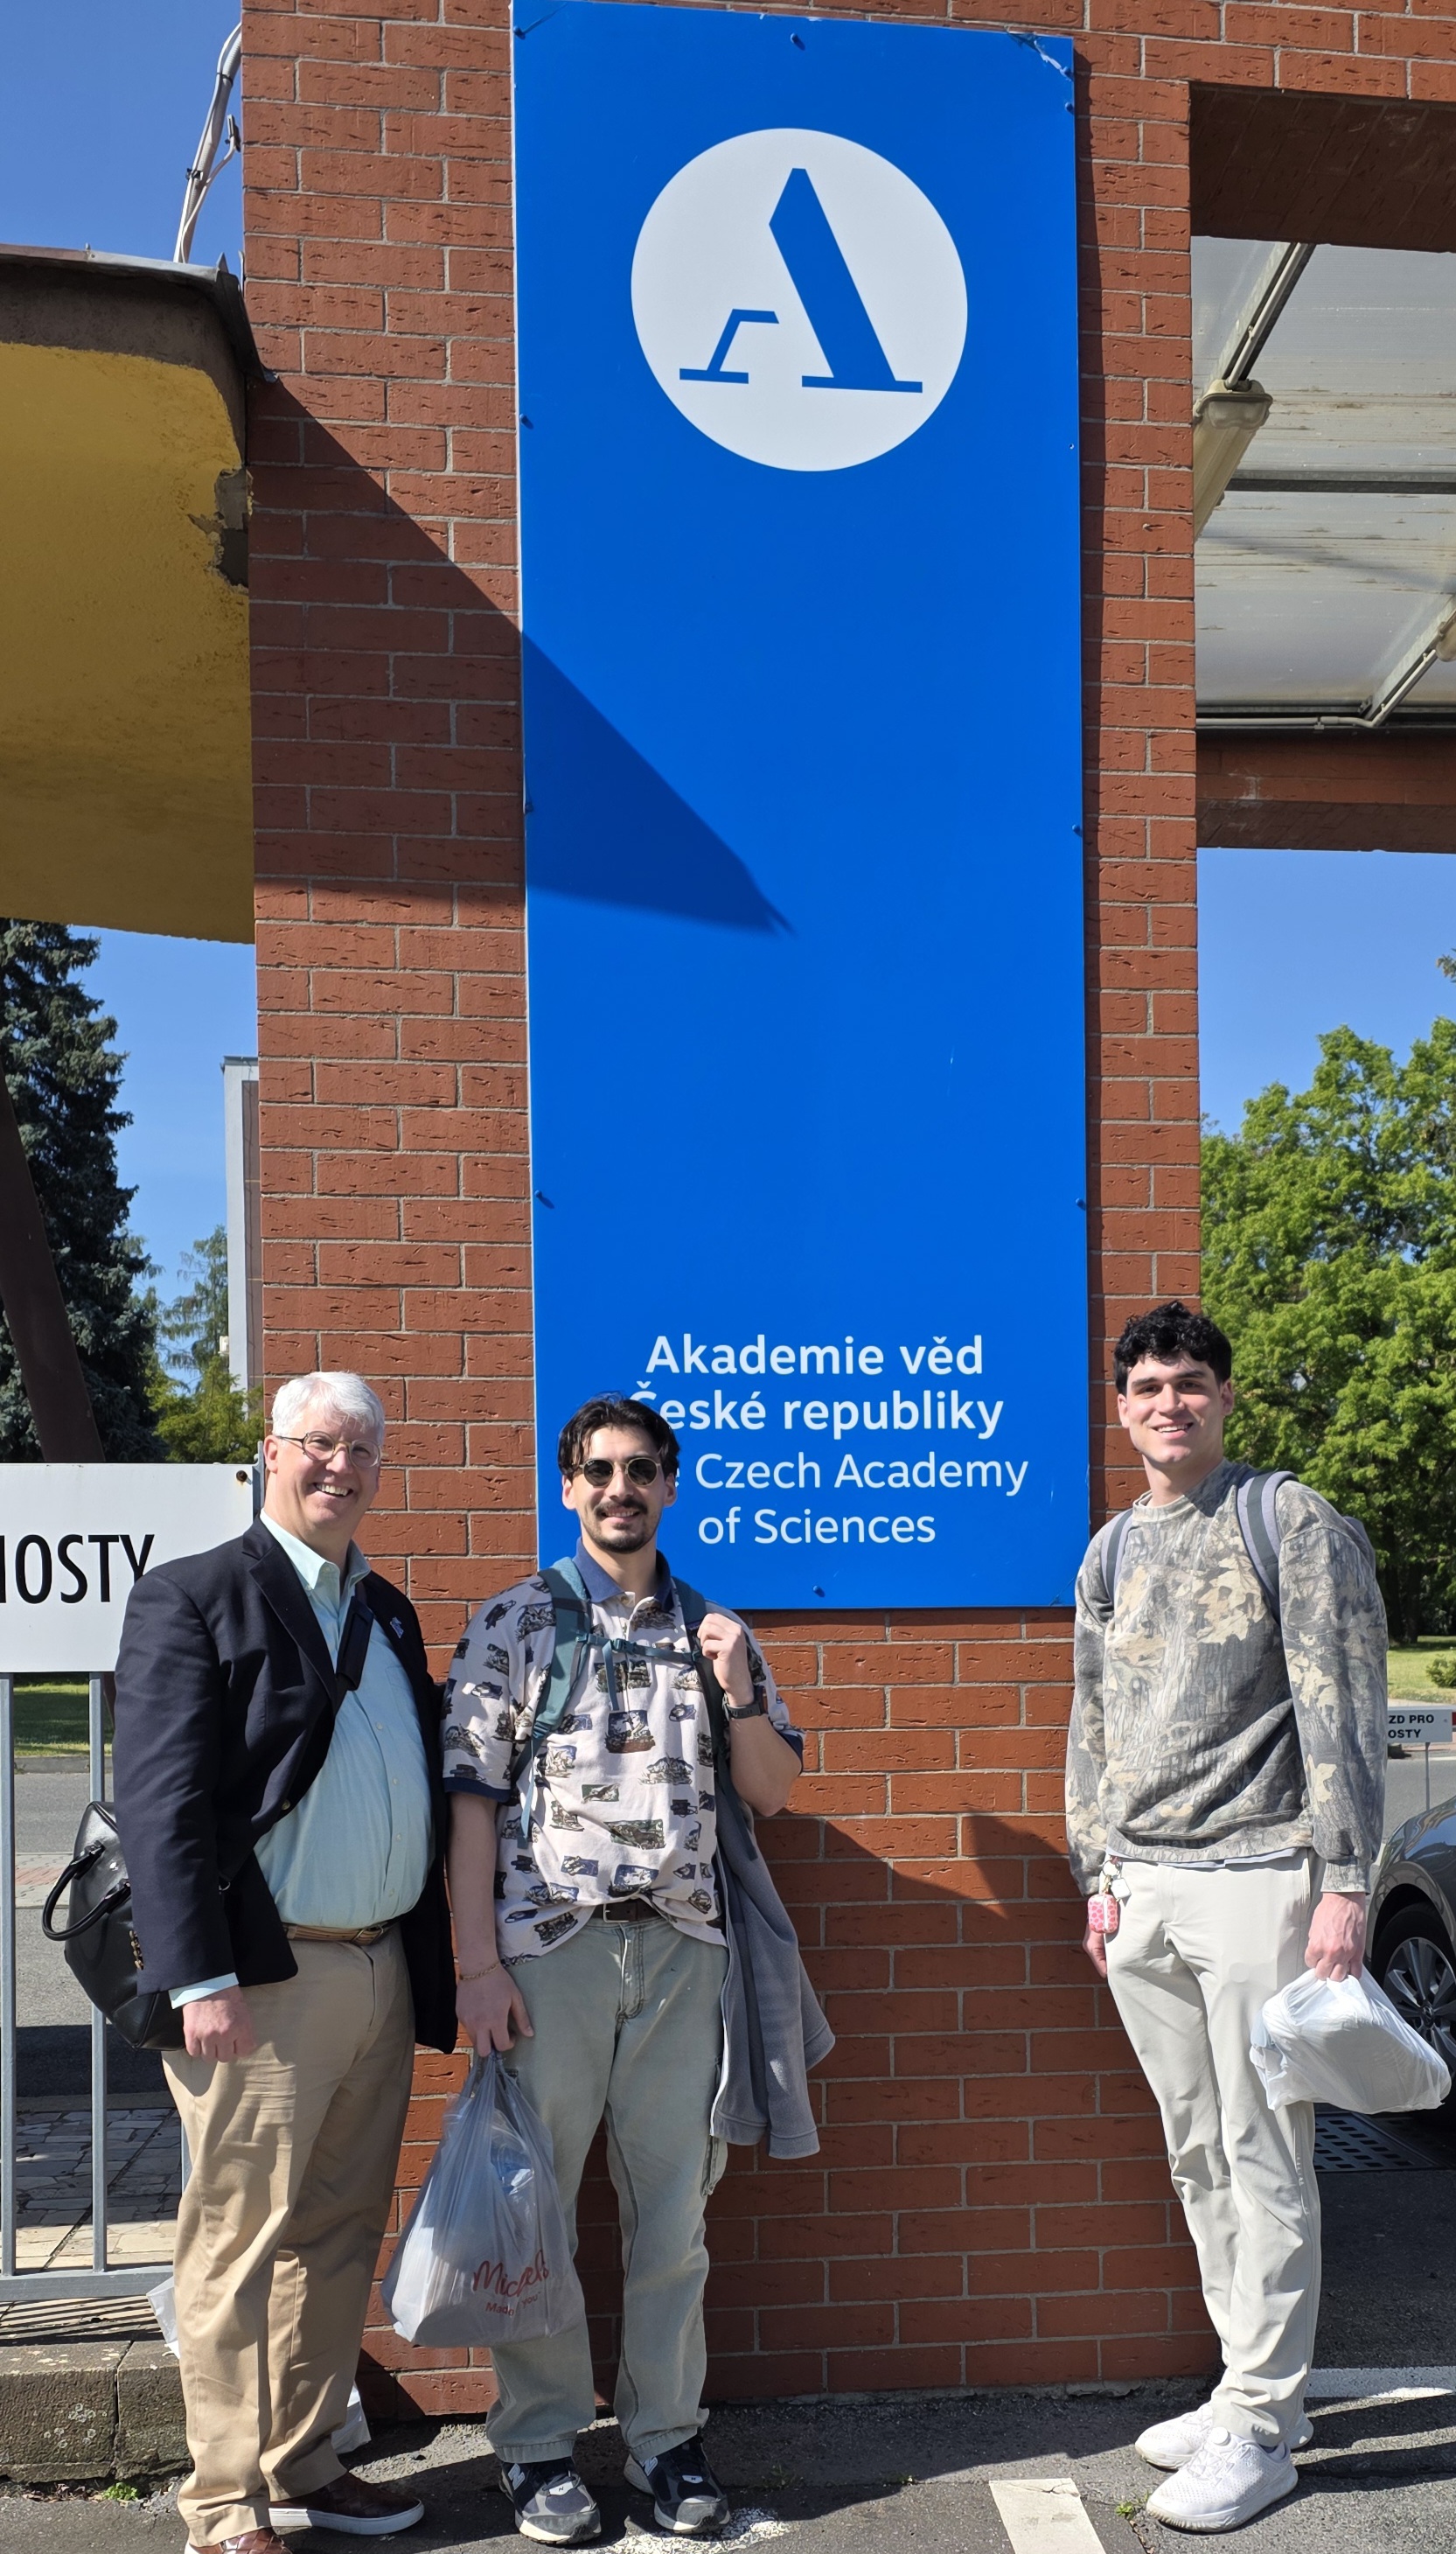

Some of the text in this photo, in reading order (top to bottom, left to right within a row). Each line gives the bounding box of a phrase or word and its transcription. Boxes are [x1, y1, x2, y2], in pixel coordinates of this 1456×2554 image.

[645, 1333, 983, 1375] Akademie věd
[784, 1389, 1004, 1441] republiky
[695, 1451, 820, 1489] Czech
[834, 1451, 1028, 1497] Academy
[698, 1506, 936, 1545] of Sciences
[0, 1534, 155, 1604] OSTY
[1409, 1713, 1435, 1724] PRO
